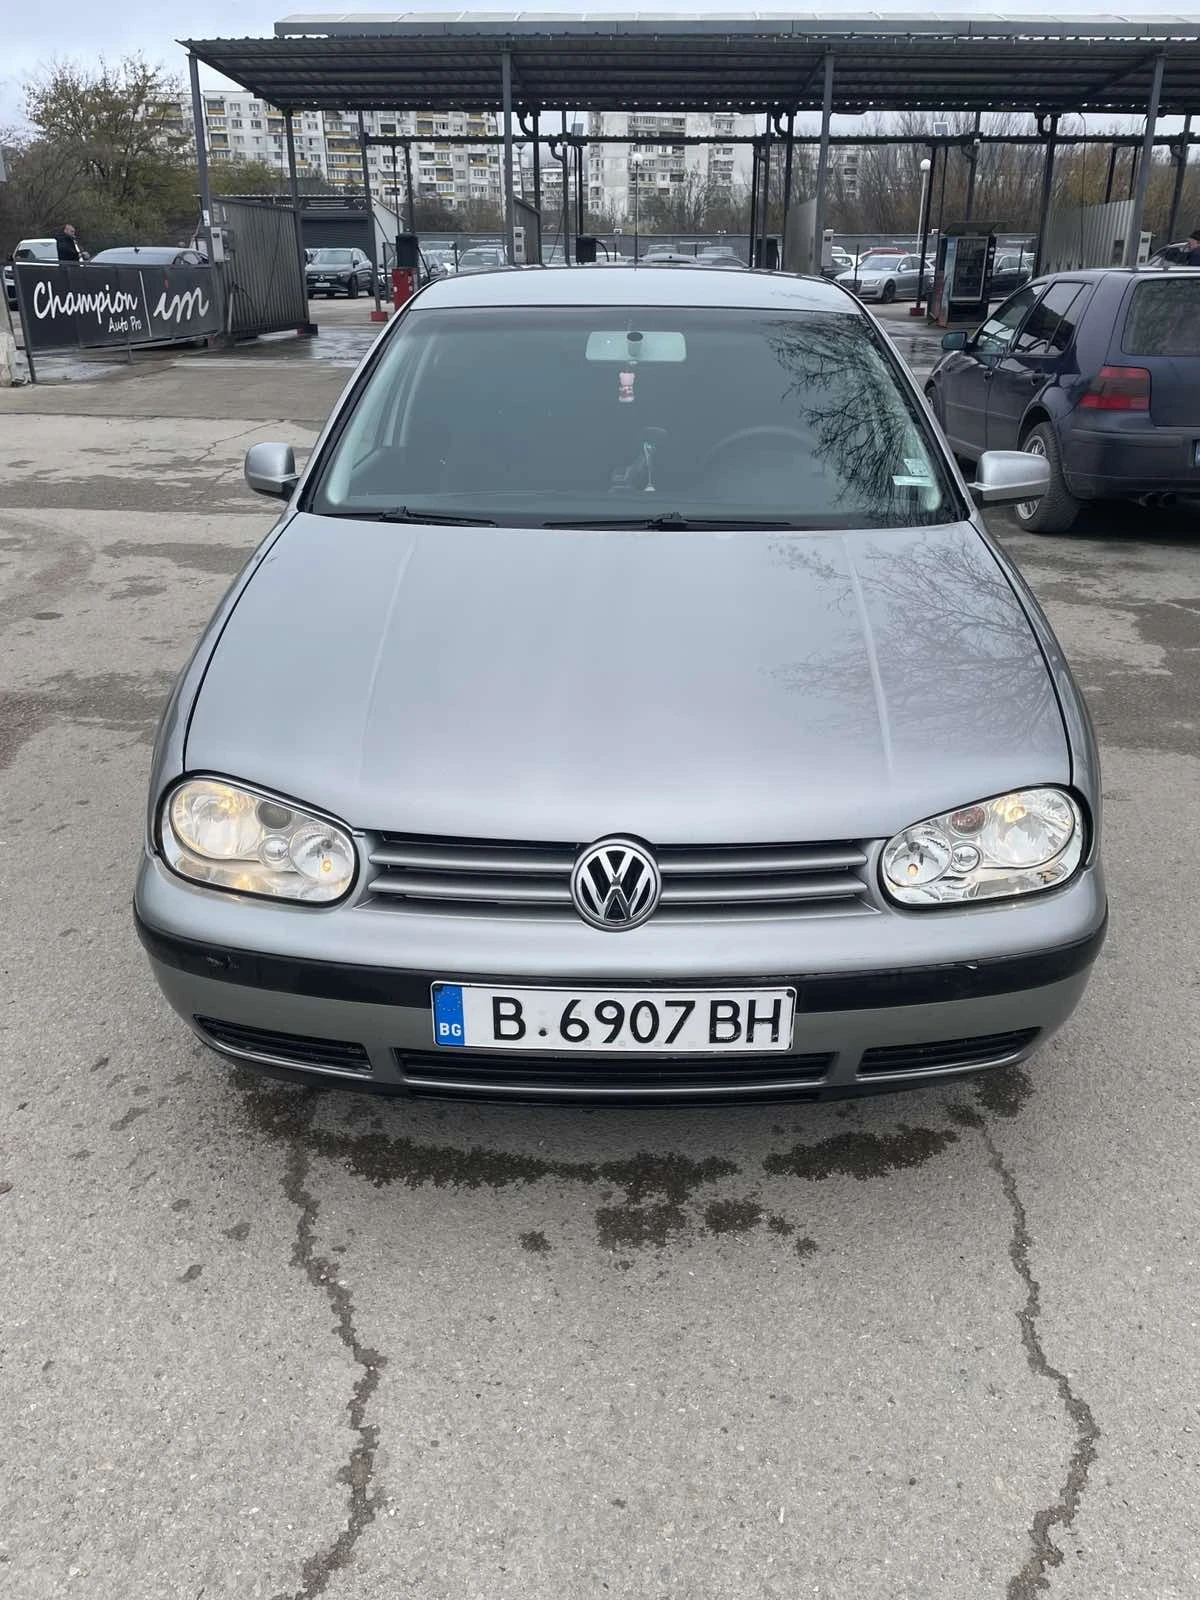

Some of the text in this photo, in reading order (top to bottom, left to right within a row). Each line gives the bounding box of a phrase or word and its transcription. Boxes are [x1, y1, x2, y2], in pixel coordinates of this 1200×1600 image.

[33, 281, 138, 324] Champion
[108, 315, 142, 333] Auto Pro
[440, 1022, 461, 1036] BG
[559, 999, 696, 1044] 6907
[709, 999, 783, 1044] BH
